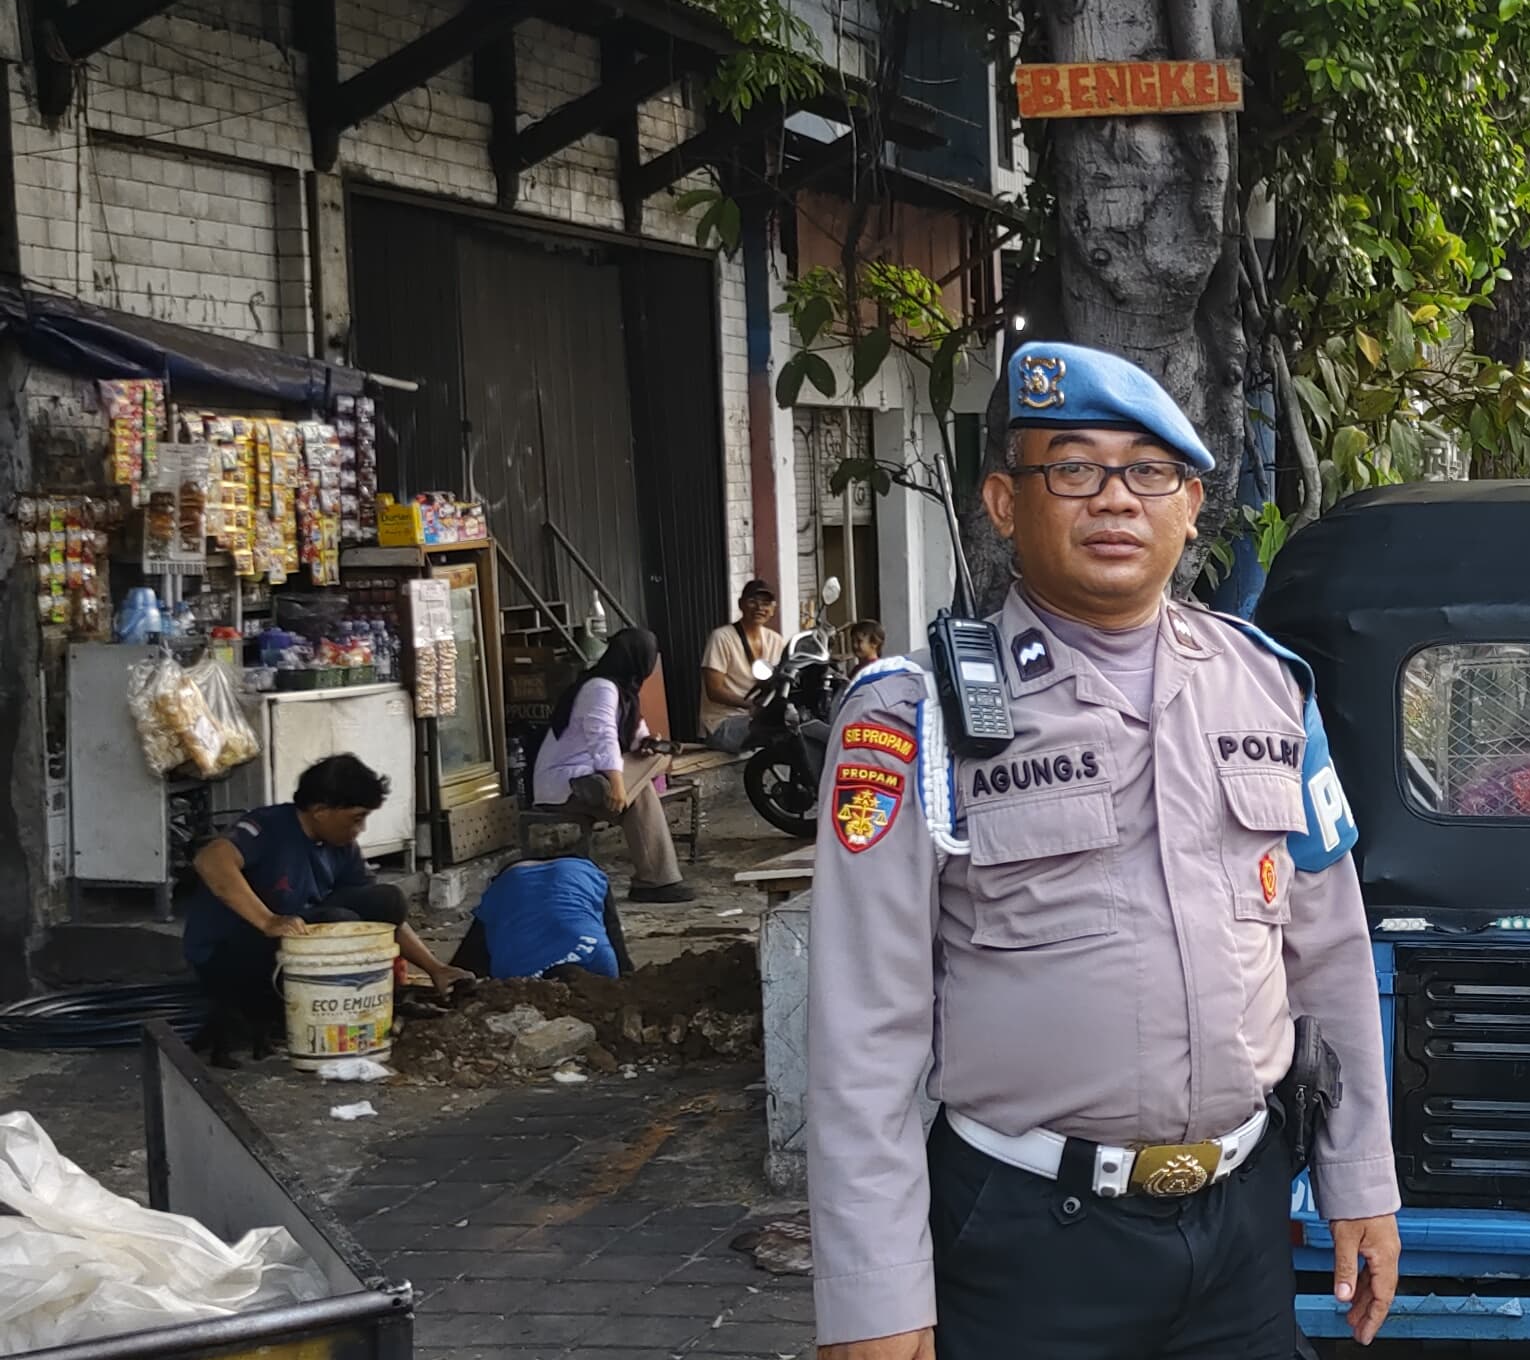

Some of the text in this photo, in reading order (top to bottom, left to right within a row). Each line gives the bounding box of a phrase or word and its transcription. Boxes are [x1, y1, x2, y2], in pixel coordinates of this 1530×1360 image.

[1028, 64, 1239, 115] BENGKEL
[862, 728, 914, 756] PROPAM
[1217, 735, 1300, 770] POLRI
[842, 767, 899, 786] PROPAM
[972, 751, 1100, 798] AGUNG.S
[312, 999, 338, 1013] ECO
